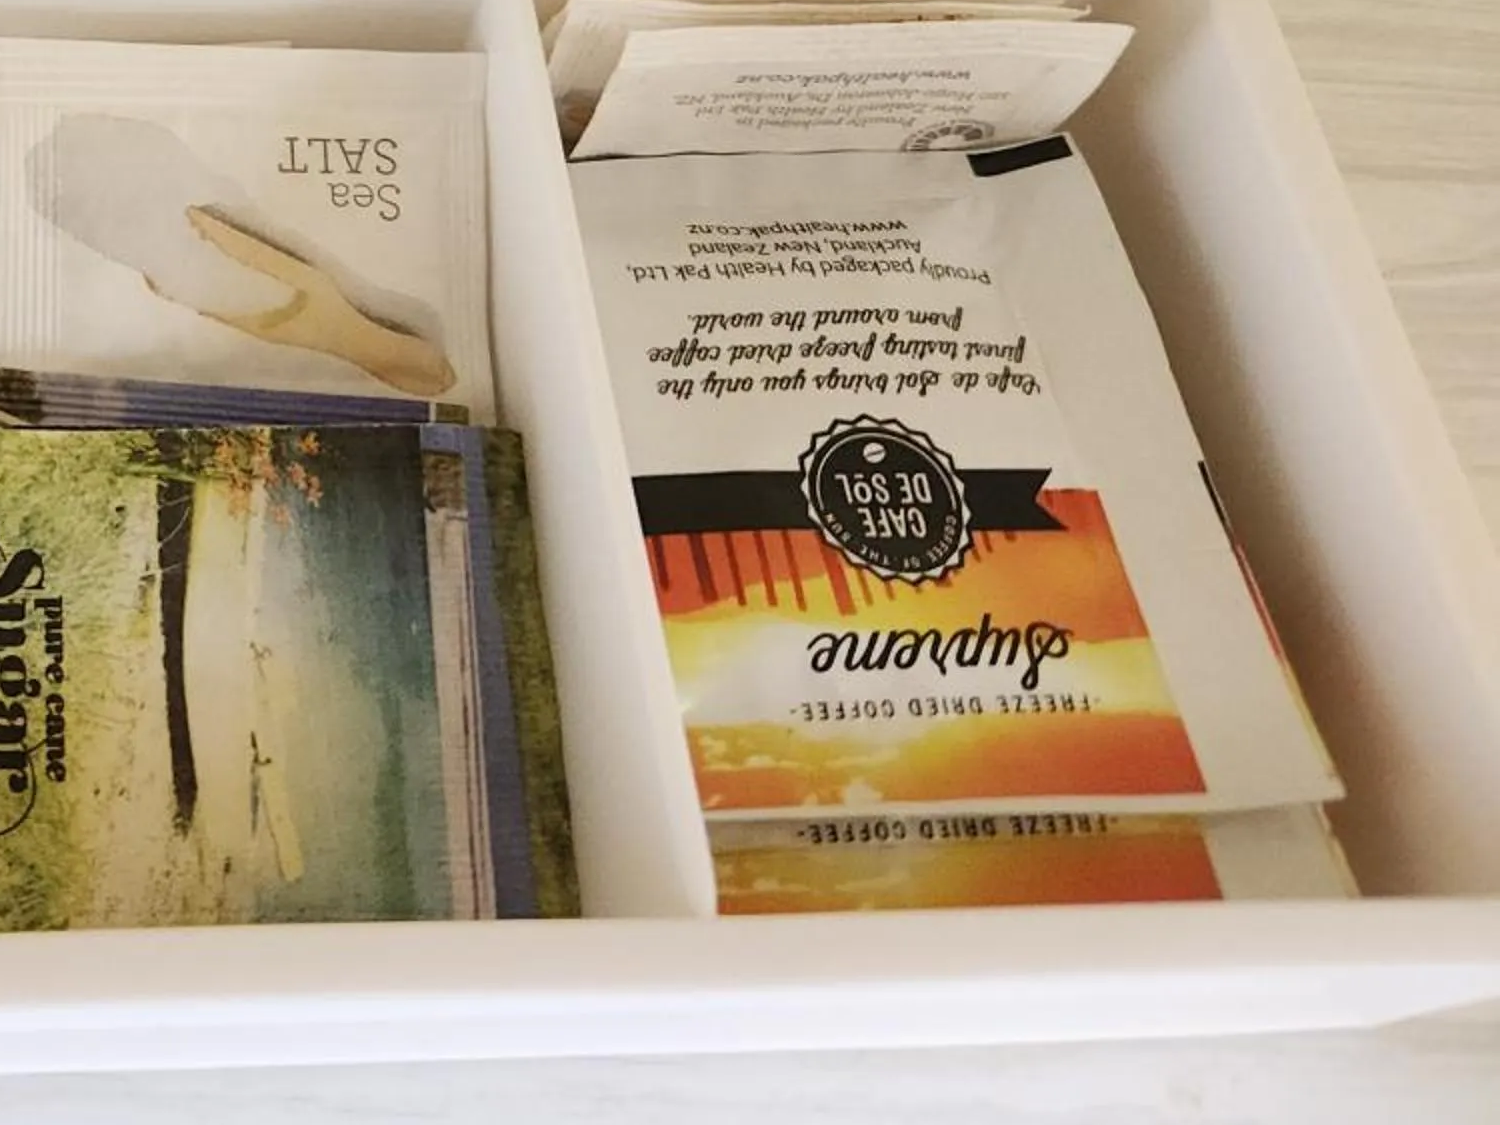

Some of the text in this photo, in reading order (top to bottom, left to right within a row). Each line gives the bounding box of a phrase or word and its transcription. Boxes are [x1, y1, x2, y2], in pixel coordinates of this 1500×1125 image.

[277, 135, 400, 177] SALT
[329, 181, 402, 223] Sea
[685, 219, 908, 239] www.healthpak.co.nz
[687, 237, 922, 258] Auckland, New Zealand
[674, 264, 712, 282] Pak
[715, 261, 786, 280] Health
[791, 256, 817, 277] by
[820, 254, 915, 277] packaged
[919, 256, 992, 285] Proudly
[688, 306, 964, 335] from around the world.
[646, 331, 1027, 368] finest tasting freeze dried coffee
[657, 365, 1041, 401] Cafe de Sol brings you only the
[894, 472, 933, 505] DE
[857, 507, 928, 538] CAFE
[806, 612, 1076, 691] Supreme
[33, 594, 67, 784] pure cane
[908, 695, 984, 718] DRIED
[918, 816, 998, 840] DRIED
